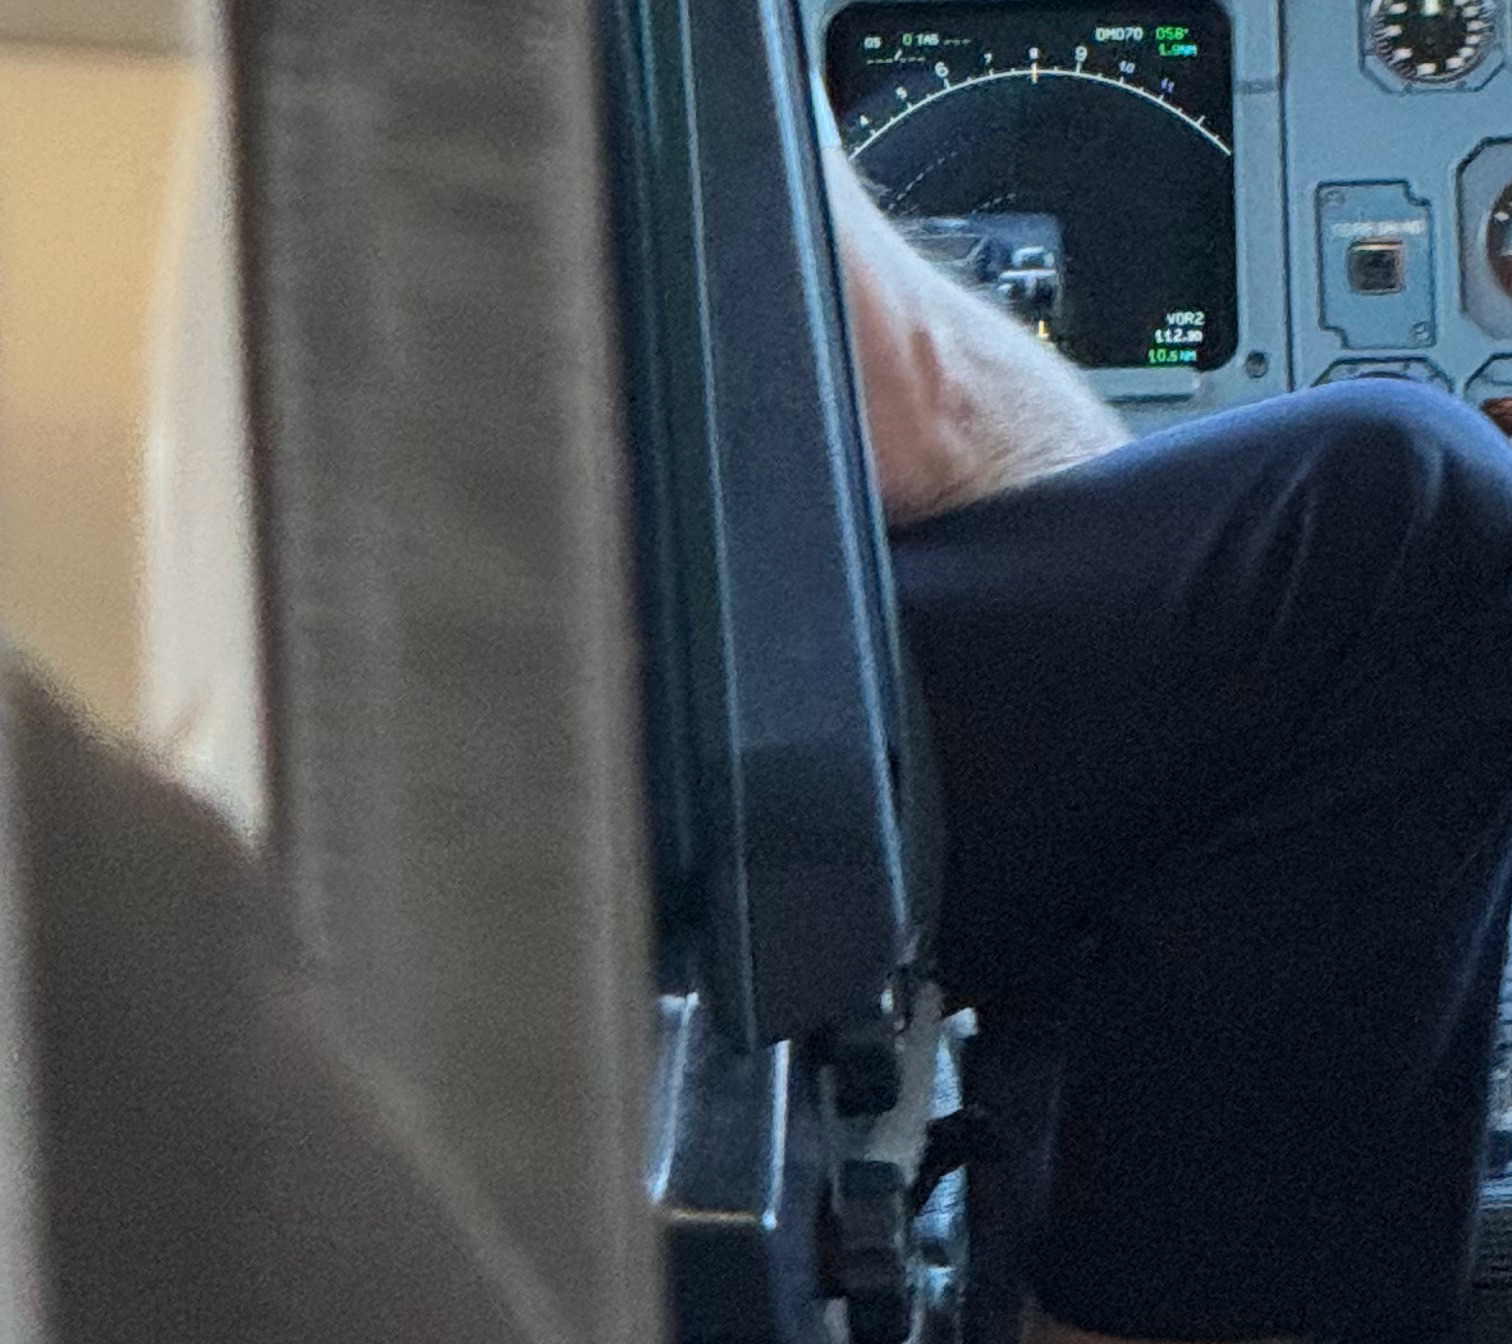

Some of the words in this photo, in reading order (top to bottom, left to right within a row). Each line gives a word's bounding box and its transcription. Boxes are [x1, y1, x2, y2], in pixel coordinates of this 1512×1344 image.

[1074, 46, 1088, 62] 9
[934, 61, 949, 78] 6
[1166, 311, 1206, 326] VOR2
